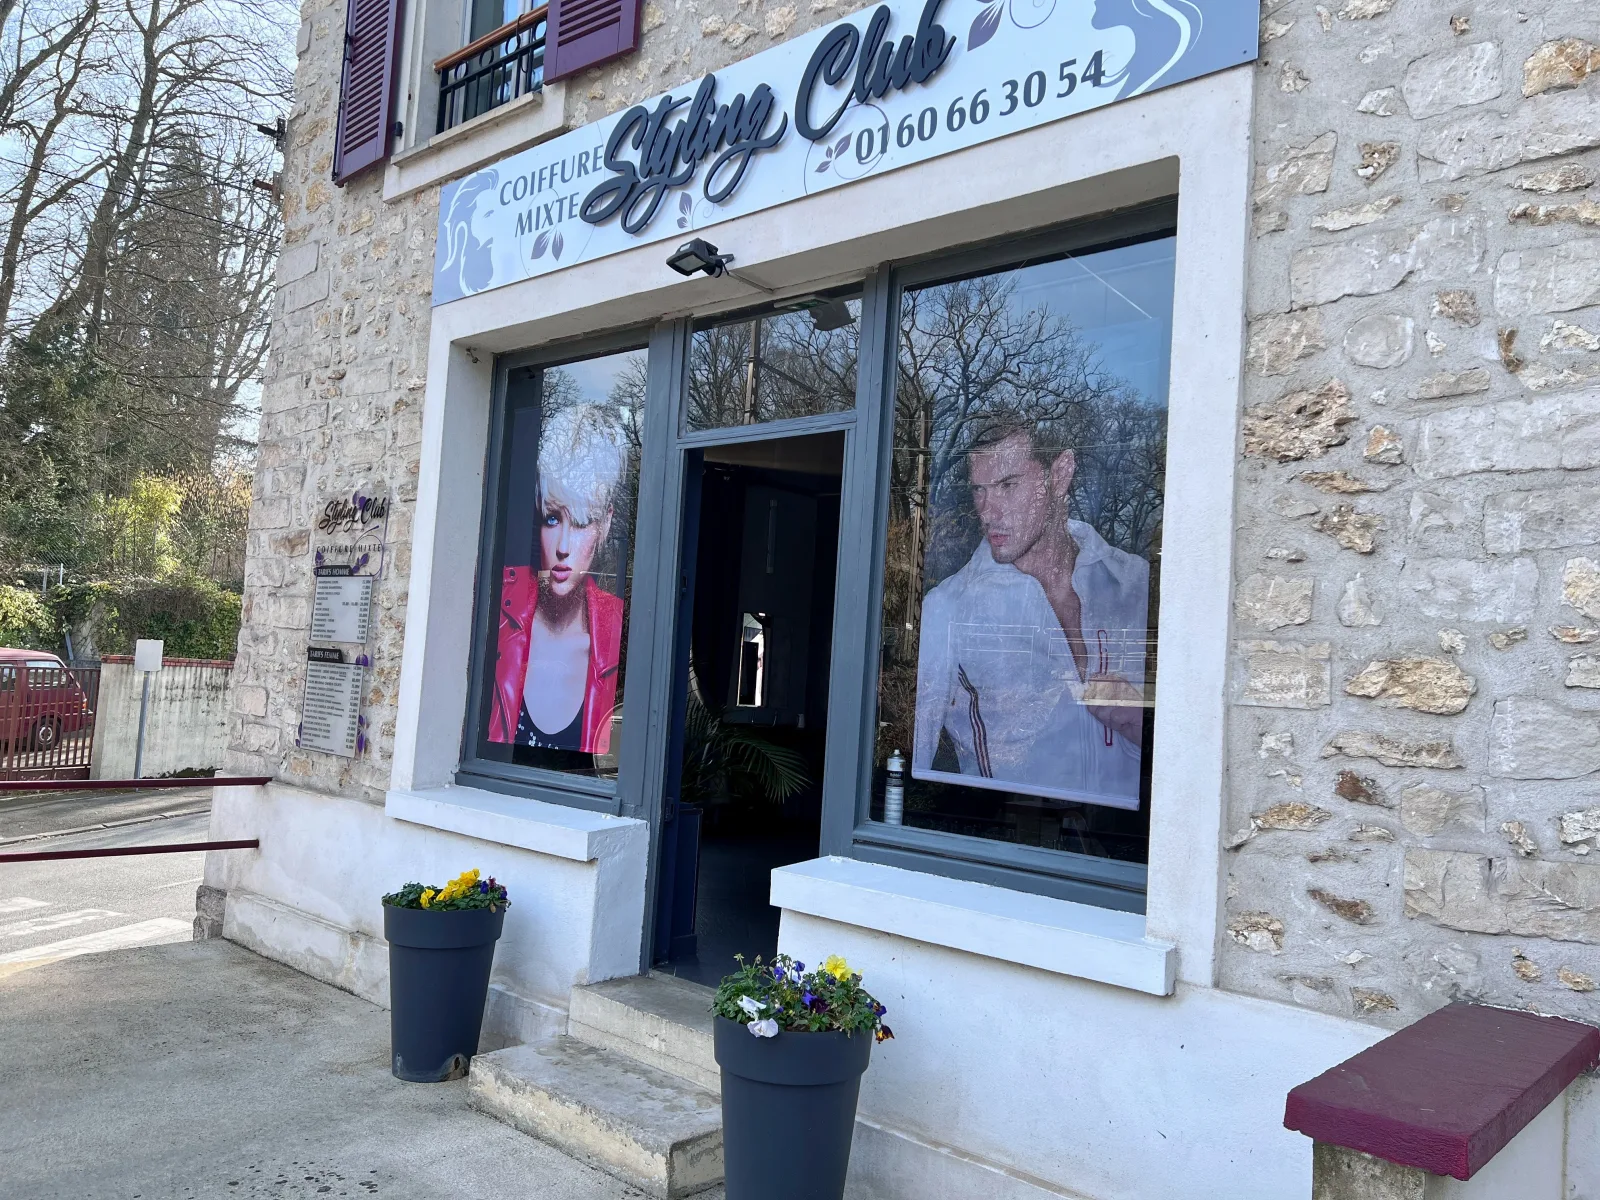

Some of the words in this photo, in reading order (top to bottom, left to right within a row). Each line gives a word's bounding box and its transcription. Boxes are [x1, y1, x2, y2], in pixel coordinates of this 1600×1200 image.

[579, 73, 789, 234] Styling
[795, 0, 957, 141] Club
[855, 122, 889, 164] 01
[896, 106, 938, 149] 60
[946, 88, 991, 132] 66
[999, 70, 1047, 117] 30
[1056, 49, 1106, 98] 54
[499, 144, 604, 207] COIFFURE
[514, 192, 580, 238] MIXTE
[318, 498, 360, 535] Styling
[361, 496, 387, 525] Club
